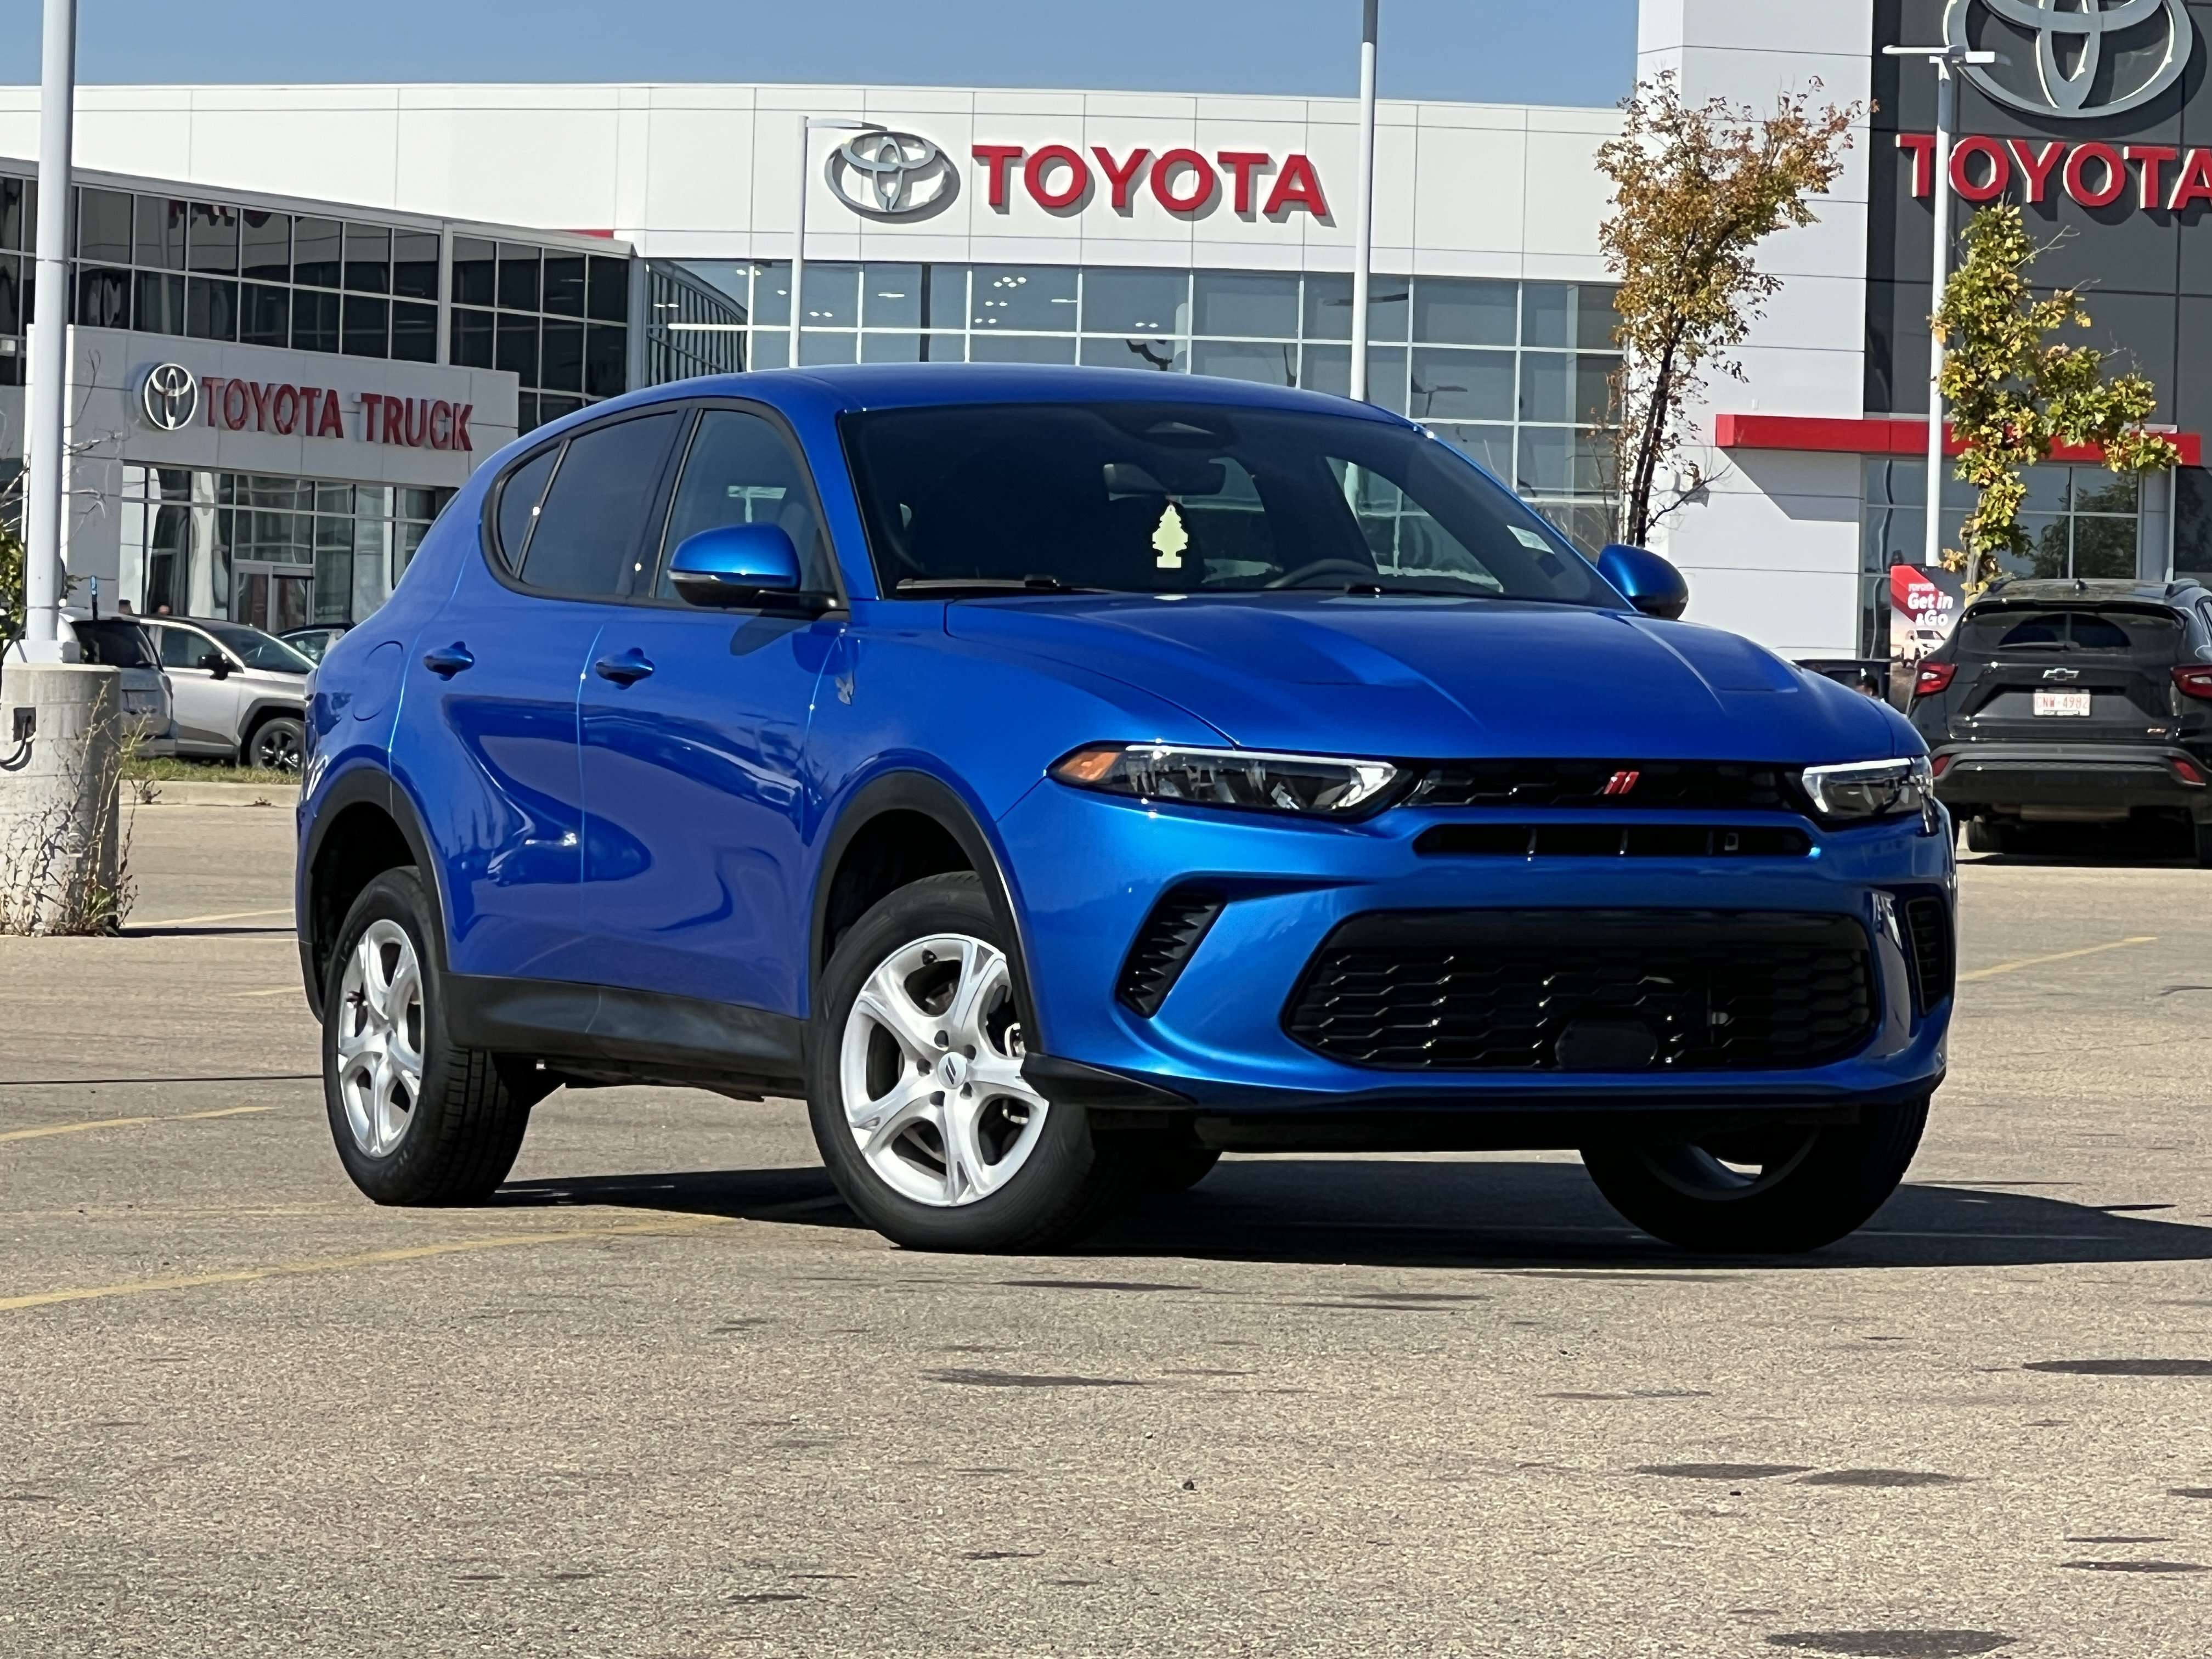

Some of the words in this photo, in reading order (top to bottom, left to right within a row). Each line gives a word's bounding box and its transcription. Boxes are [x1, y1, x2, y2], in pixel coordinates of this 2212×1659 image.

[972, 144, 1328, 216] TOYOTA
[1896, 133, 2212, 210] TOYOTA
[201, 376, 344, 438] TOYOTA
[358, 392, 473, 451] TRUCK
[1908, 592, 1936, 610] Get
[1936, 591, 1953, 610] in
